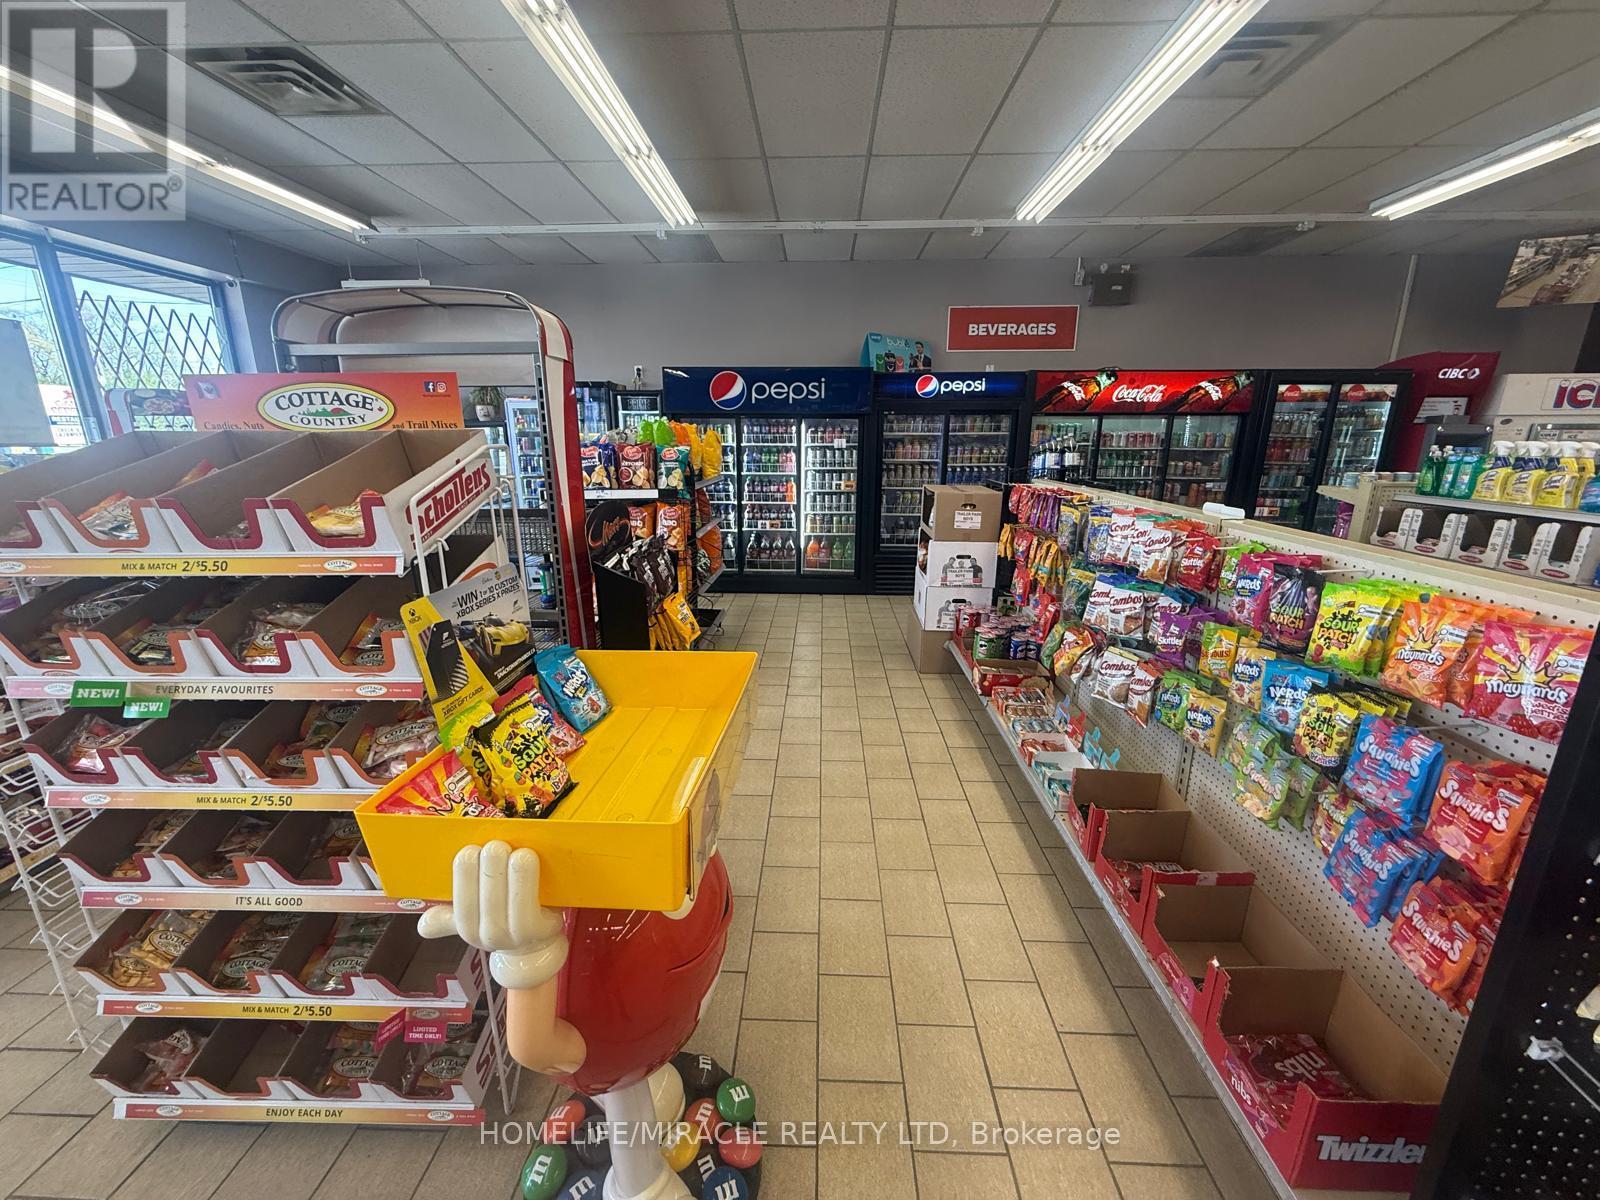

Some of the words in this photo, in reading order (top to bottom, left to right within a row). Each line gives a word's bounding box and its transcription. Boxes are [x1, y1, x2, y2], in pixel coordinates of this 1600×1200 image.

[968, 322, 1057, 337] BEVERAGES
[1438, 368, 1468, 379] CIBC
[751, 377, 826, 404] pepsi
[940, 377, 986, 395] pepsi
[274, 391, 376, 412] COTTAGE
[289, 413, 368, 428] COUNTRY
[407, 420, 430, 430] Trail
[431, 420, 459, 430] Mixes
[121, 563, 138, 571] MIX
[148, 563, 177, 571] MATCH
[182, 560, 228, 573] 2/$5.50
[456, 589, 479, 608] WIN
[494, 576, 519, 593] CUSTOM
[456, 605, 475, 620] XBOX
[475, 595, 497, 612] SERIES
[500, 583, 520, 598] PRIZES
[1110, 593, 1143, 606] Combos
[1322, 617, 1360, 633] SOUR
[1317, 628, 1358, 644] PATCH
[77, 688, 120, 699] NEW!
[155, 685, 207, 695] EVERYDAY
[211, 685, 274, 695] FAVOURITES
[1269, 686, 1309, 701] Nerds
[130, 702, 163, 712] NEW!
[1187, 710, 1214, 724] Nerds
[196, 796, 211, 804] MIX
[220, 796, 247, 804] MATCH
[250, 795, 293, 807] 2/$5.50
[235, 896, 252, 906] IT'S
[255, 897, 272, 906] ALL
[274, 897, 303, 906] GOOD
[158, 933, 191, 948] COTTAG
[332, 959, 366, 967] COTTAG
[264, 1006, 290, 1014] MATCH
[293, 1005, 332, 1017] 2/$5.50
[1231, 1074, 1253, 1106] nibs
[266, 1108, 296, 1117] ENJOY
[298, 1109, 321, 1118] EACH
[324, 1109, 343, 1118] DAY
